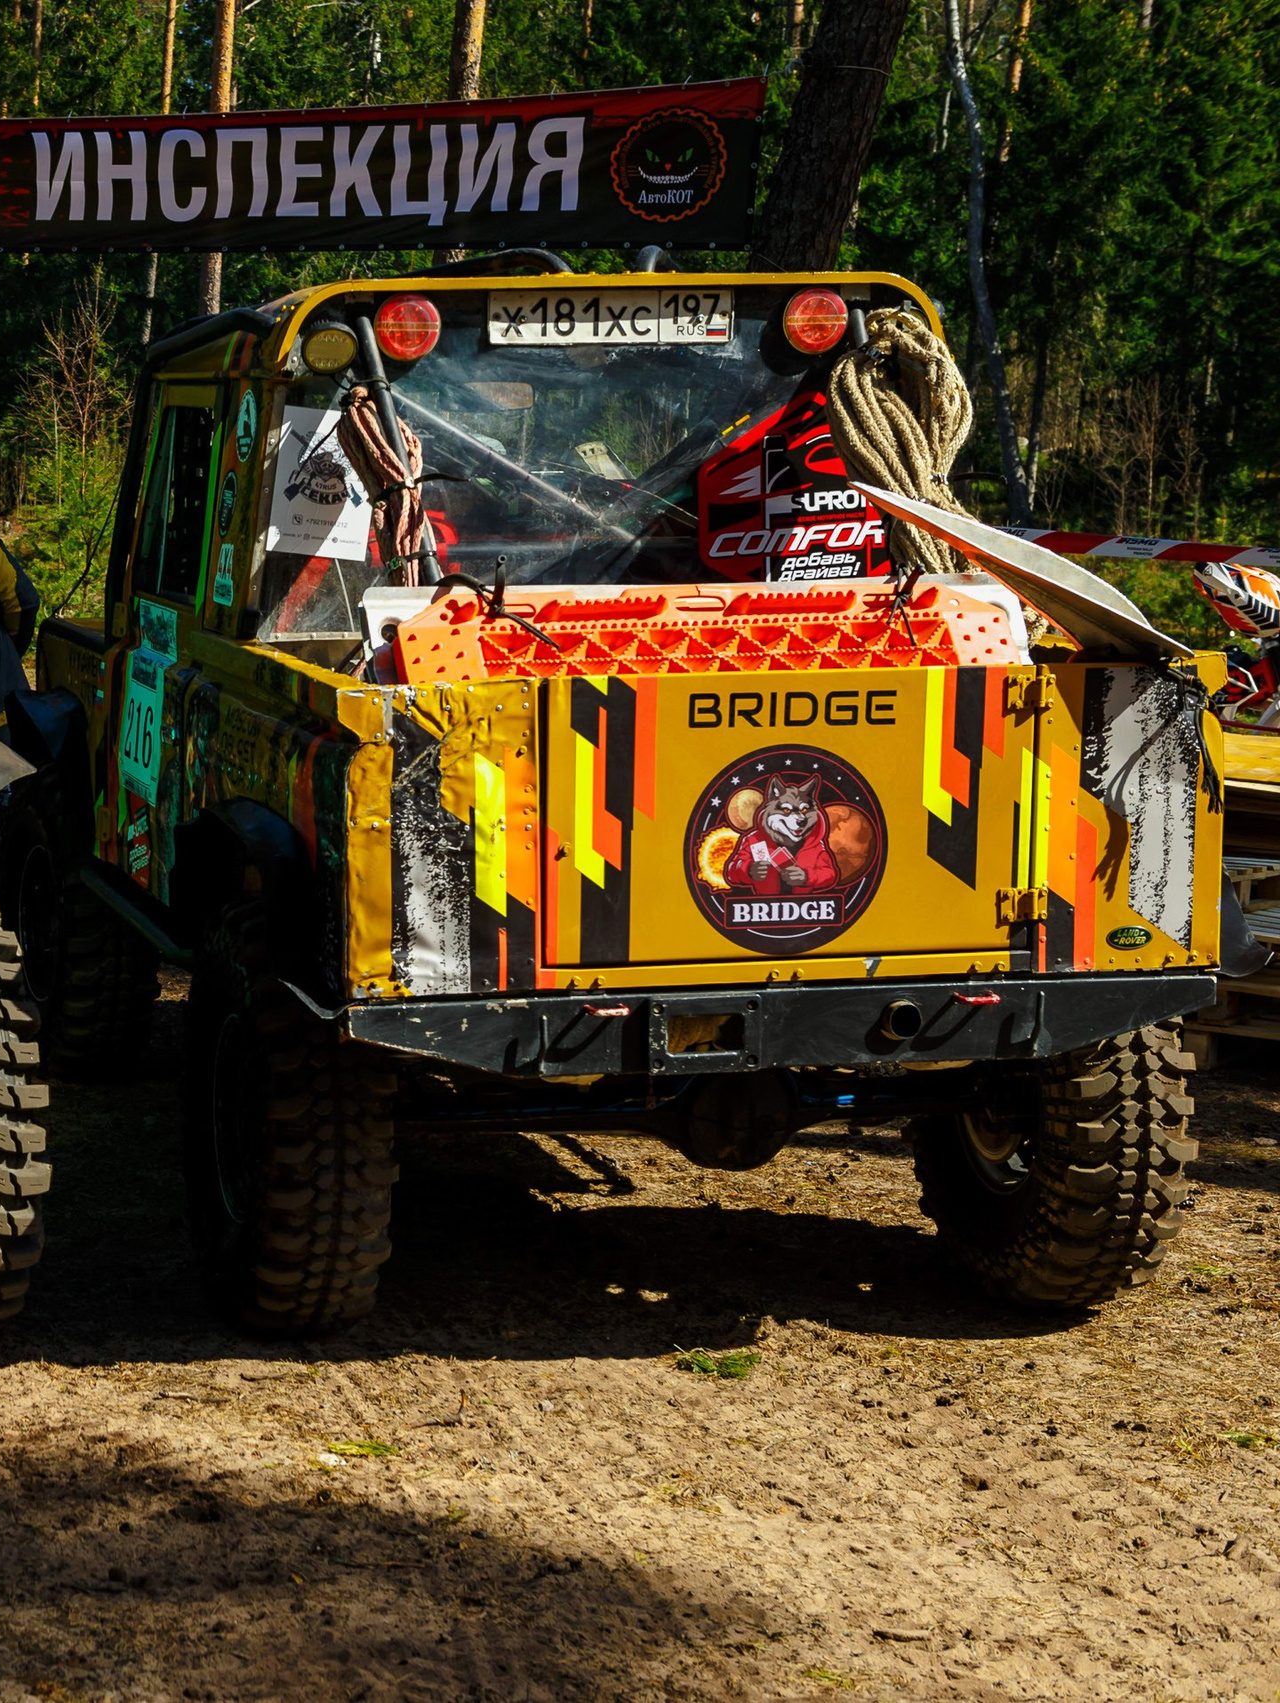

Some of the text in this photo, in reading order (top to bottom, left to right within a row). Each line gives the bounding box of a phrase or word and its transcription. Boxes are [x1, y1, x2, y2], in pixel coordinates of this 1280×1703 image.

[31, 117, 586, 226] ИНСПЕКЦИЯ
[663, 293, 720, 327] 197
[676, 325, 705, 336] RUS
[778, 562, 861, 582] драйва!
[781, 552, 856, 571] добавь
[688, 690, 898, 729] BRIDGE
[125, 699, 154, 769] 216
[732, 900, 836, 923] BRIDGE
[1117, 929, 1140, 937] LAND
[1118, 936, 1147, 945] ROVER
